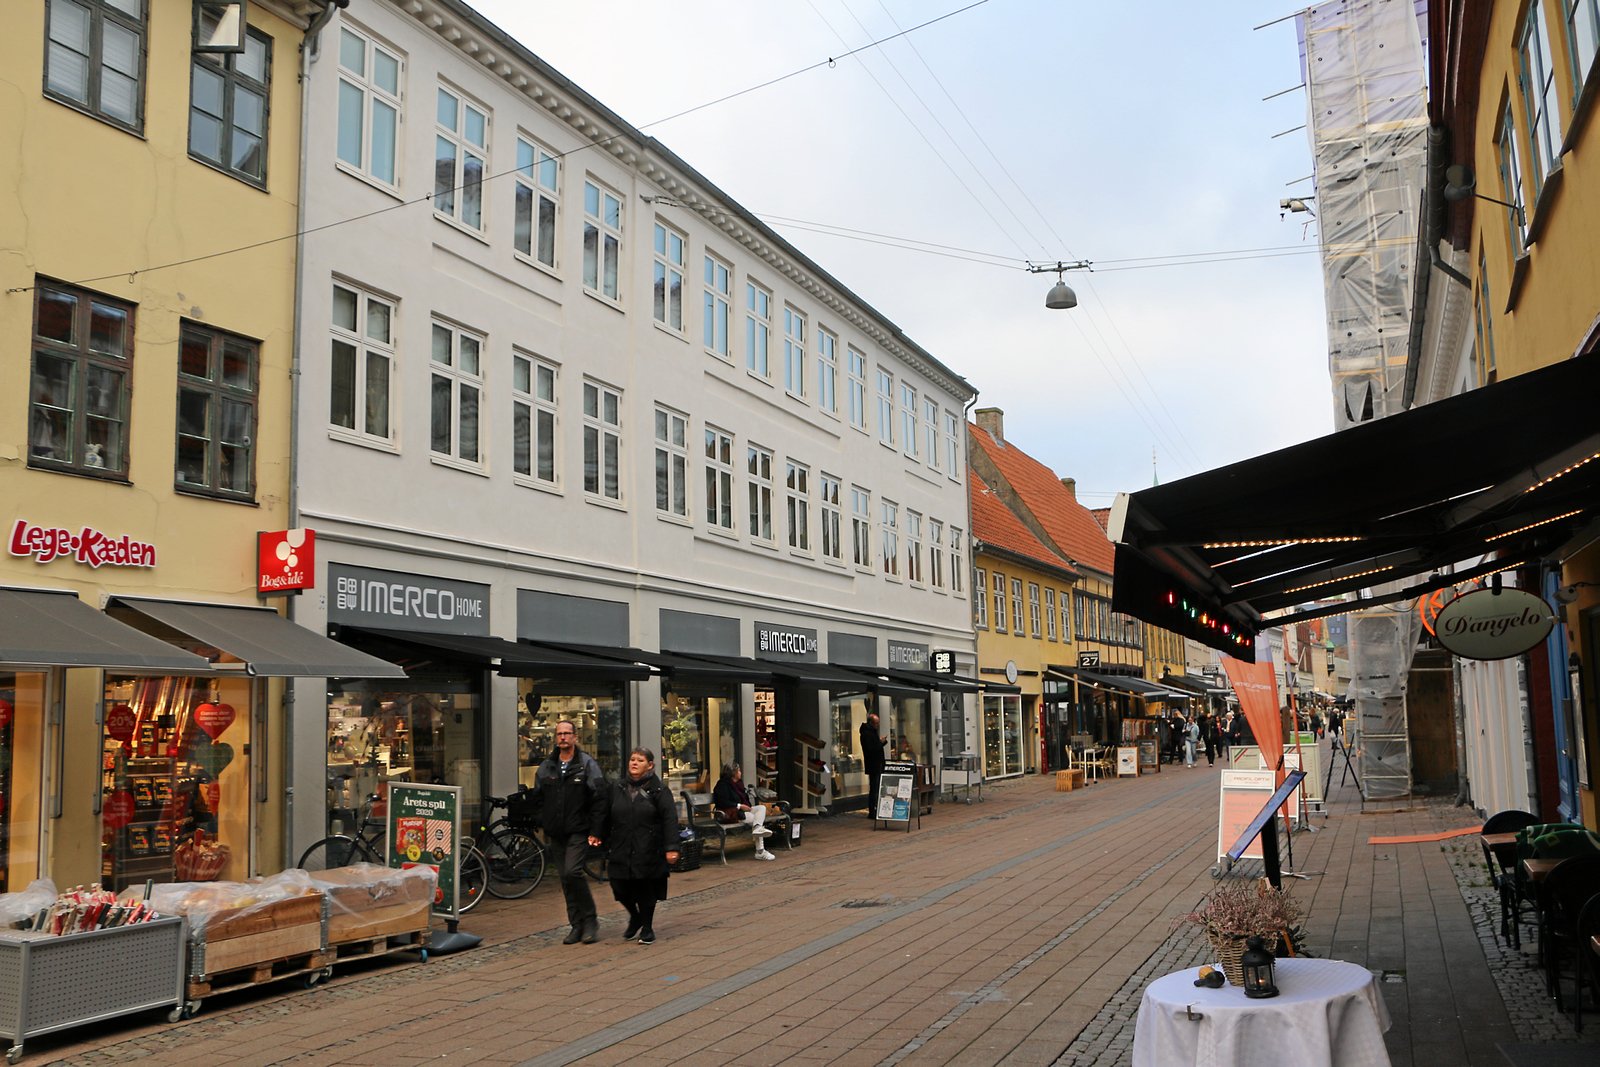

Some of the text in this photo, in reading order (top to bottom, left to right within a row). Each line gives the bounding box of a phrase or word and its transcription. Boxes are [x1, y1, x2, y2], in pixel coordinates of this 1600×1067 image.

[360, 579, 482, 621] IMERCO HOME
[1445, 607, 1540, 638] D'angelo
[768, 630, 807, 654] IMERCO
[895, 646, 921, 664] IMERCO
[1082, 657, 1098, 666] 27
[415, 808, 433, 816] 2020
[428, 801, 446, 809] spil
